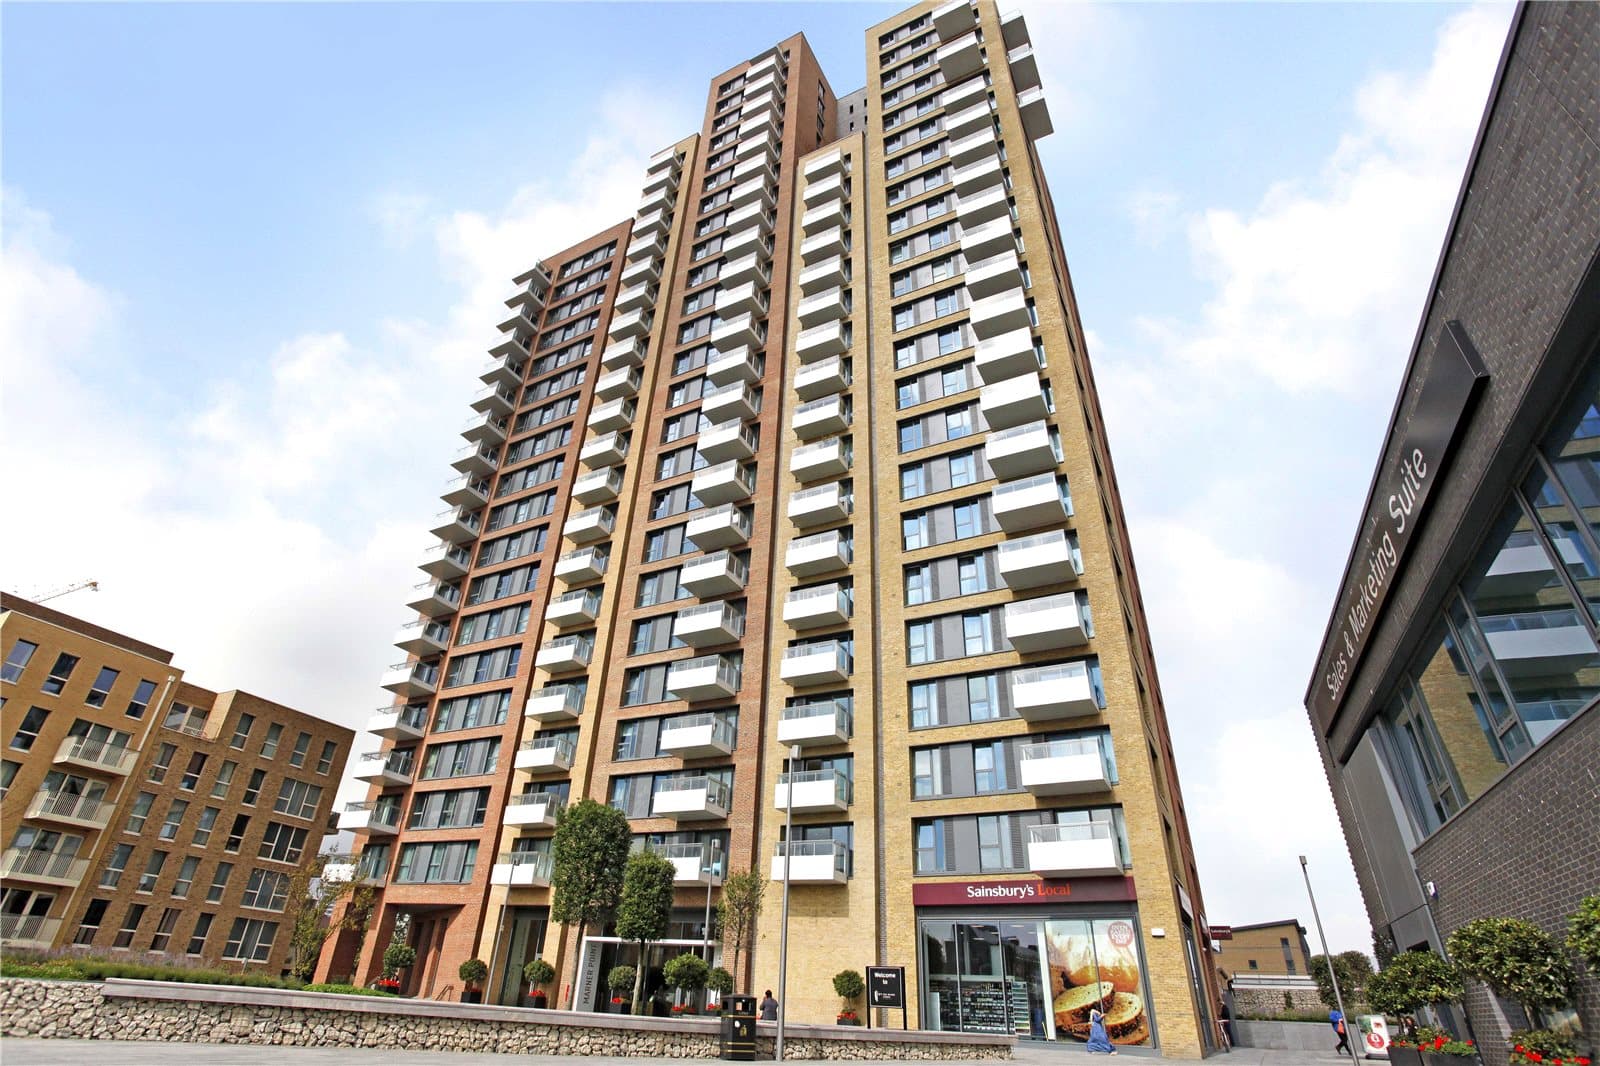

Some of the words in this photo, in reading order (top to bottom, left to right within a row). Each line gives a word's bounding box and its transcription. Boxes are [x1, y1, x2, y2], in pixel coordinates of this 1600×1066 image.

[1388, 448, 1427, 534] Suite
[1348, 530, 1397, 643] Marketing
[1343, 630, 1354, 659] &
[1326, 652, 1348, 701] Sales
[966, 884, 1035, 899] Sainsbury's
[1037, 881, 1072, 897] Local
[583, 970, 593, 1005] MARNER
